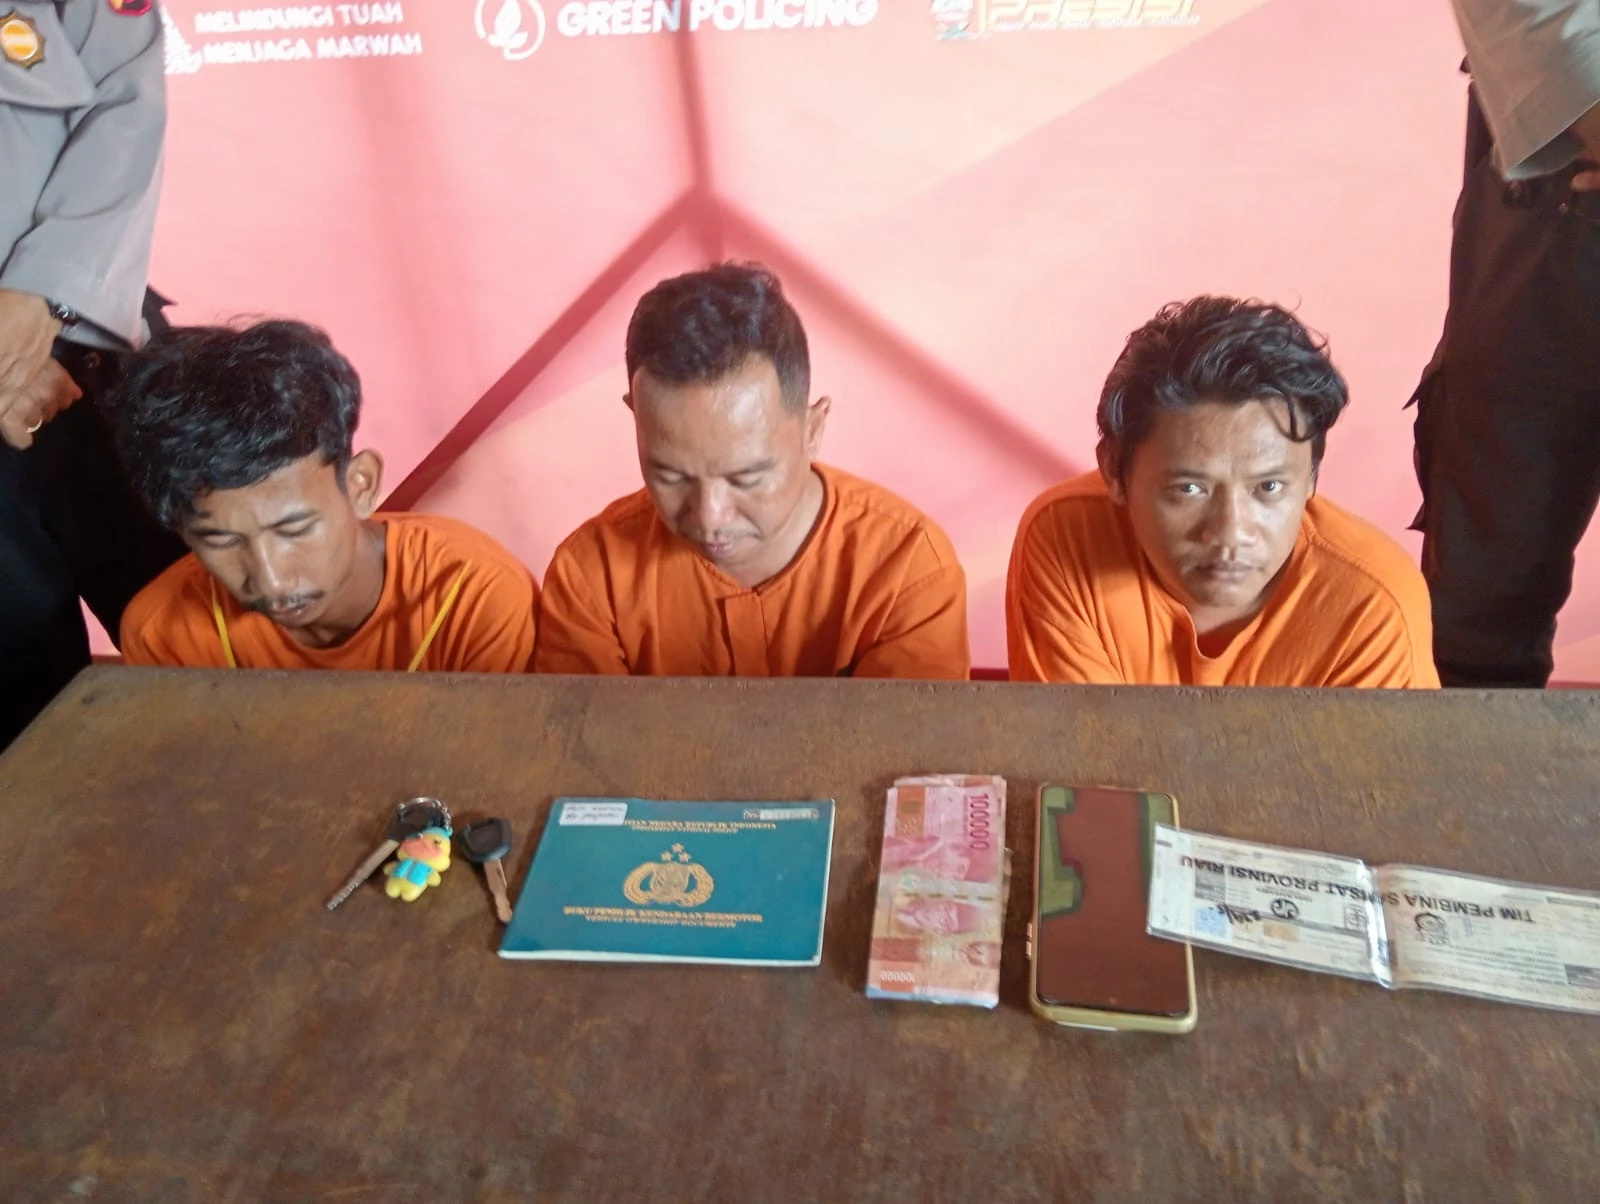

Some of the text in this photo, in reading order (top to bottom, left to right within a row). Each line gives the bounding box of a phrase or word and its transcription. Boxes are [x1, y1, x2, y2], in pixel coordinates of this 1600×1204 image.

[195, 2, 404, 33] MELINDUNGI TUAH
[557, 0, 879, 37] GREEN POLICING
[204, 33, 423, 64] MENJAGA MARWAH
[970, 793, 990, 850] 100000
[1181, 855, 1225, 874] RIAU
[1229, 864, 1321, 892] PROVINSI
[1408, 893, 1495, 918] PEMBINA
[1499, 907, 1536, 924] TIM
